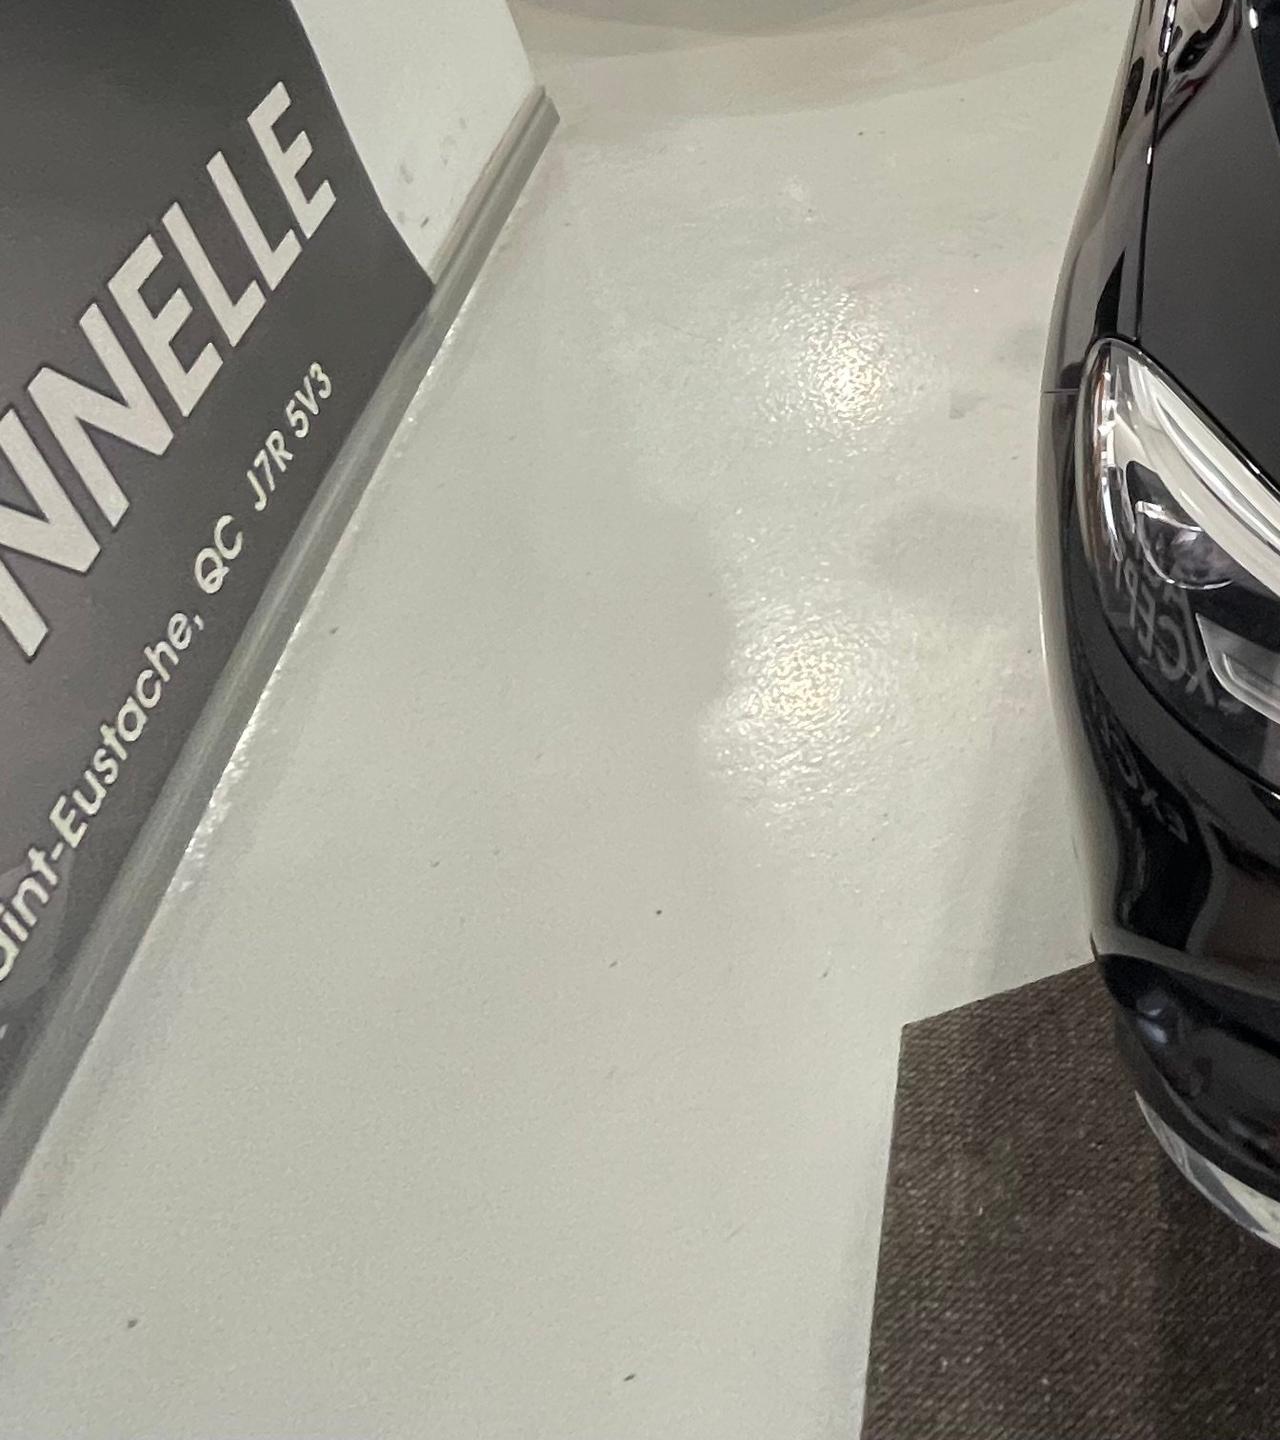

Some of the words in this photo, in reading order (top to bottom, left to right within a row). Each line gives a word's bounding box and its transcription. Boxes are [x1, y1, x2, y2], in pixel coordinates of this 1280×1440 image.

[194, 514, 244, 594] QC
[247, 430, 294, 512] J7R
[285, 361, 332, 439] 5V3
